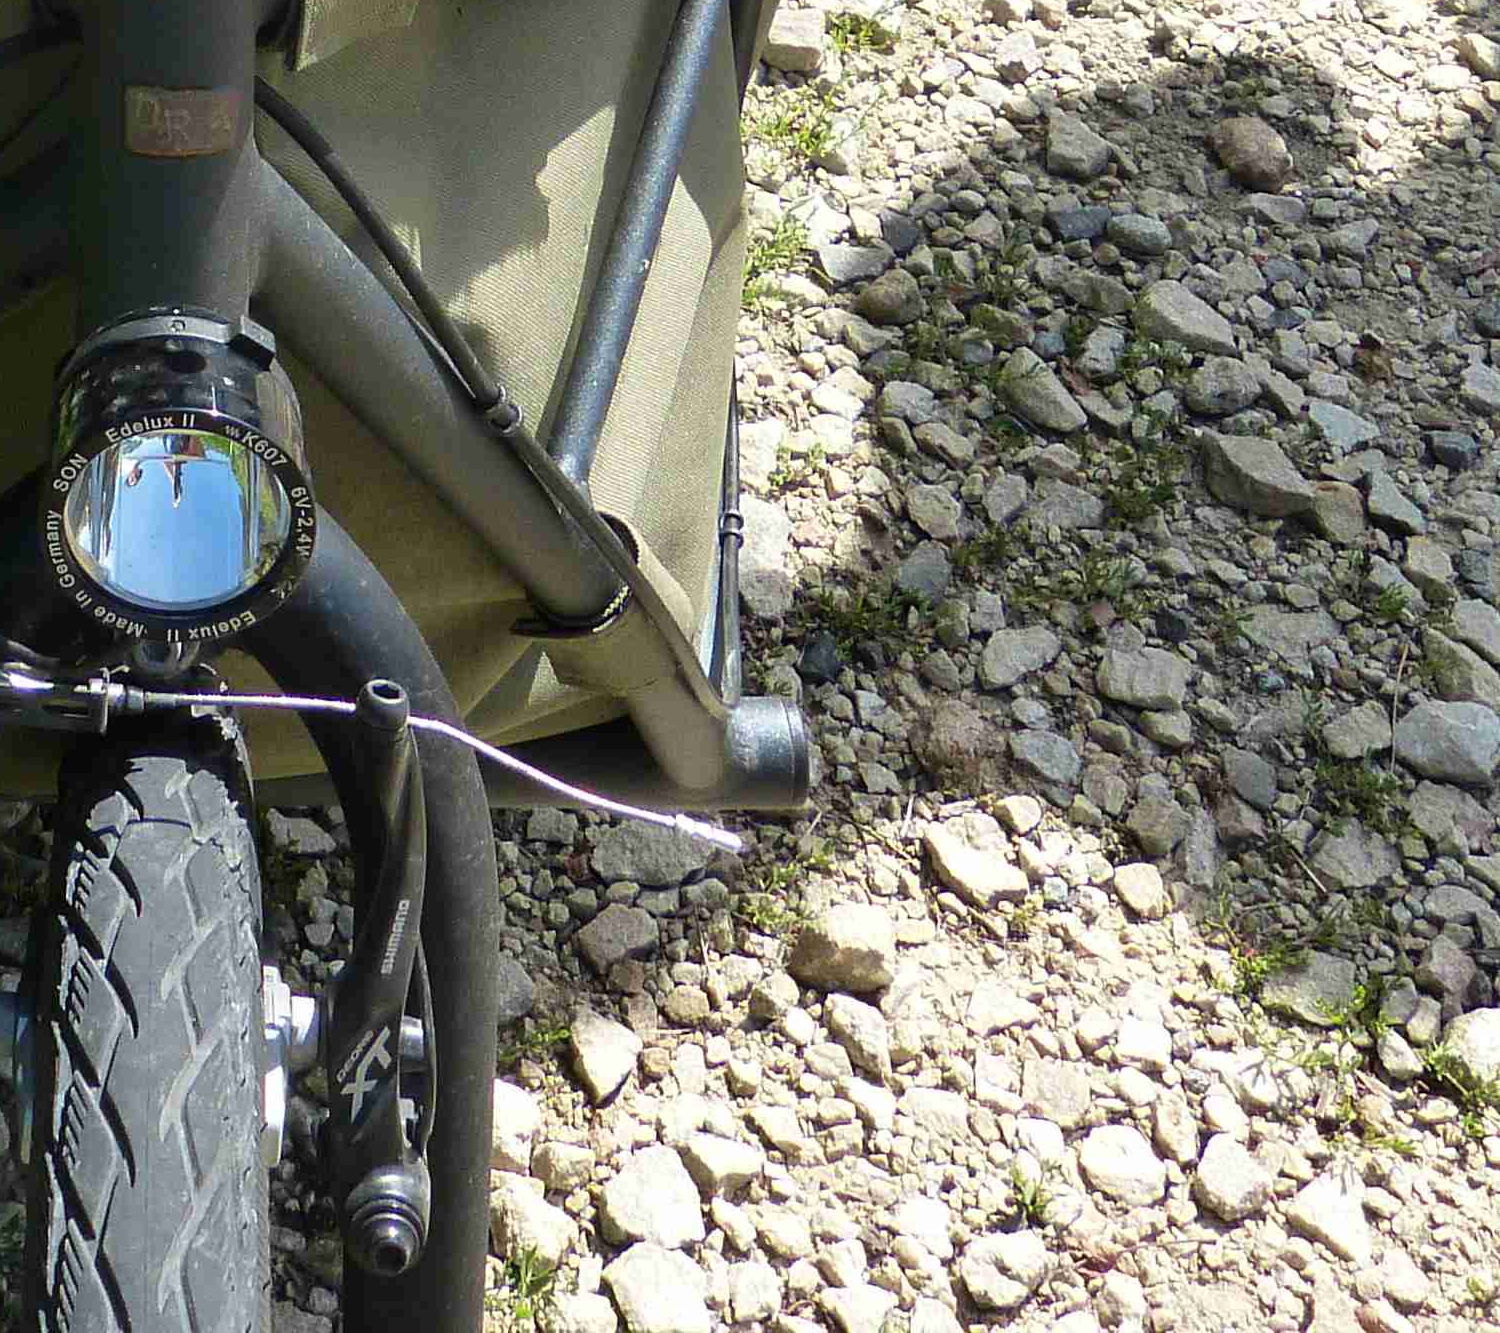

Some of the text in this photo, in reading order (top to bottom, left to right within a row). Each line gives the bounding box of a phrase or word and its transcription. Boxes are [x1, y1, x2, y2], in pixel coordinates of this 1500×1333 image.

[53, 453, 89, 494] SON
[105, 415, 174, 444] Edelux
[46, 510, 148, 639] Made in Germany
[188, 610, 257, 642] Edelux
[380, 899, 411, 975] SHIMANO
[339, 1025, 393, 1125] XT
